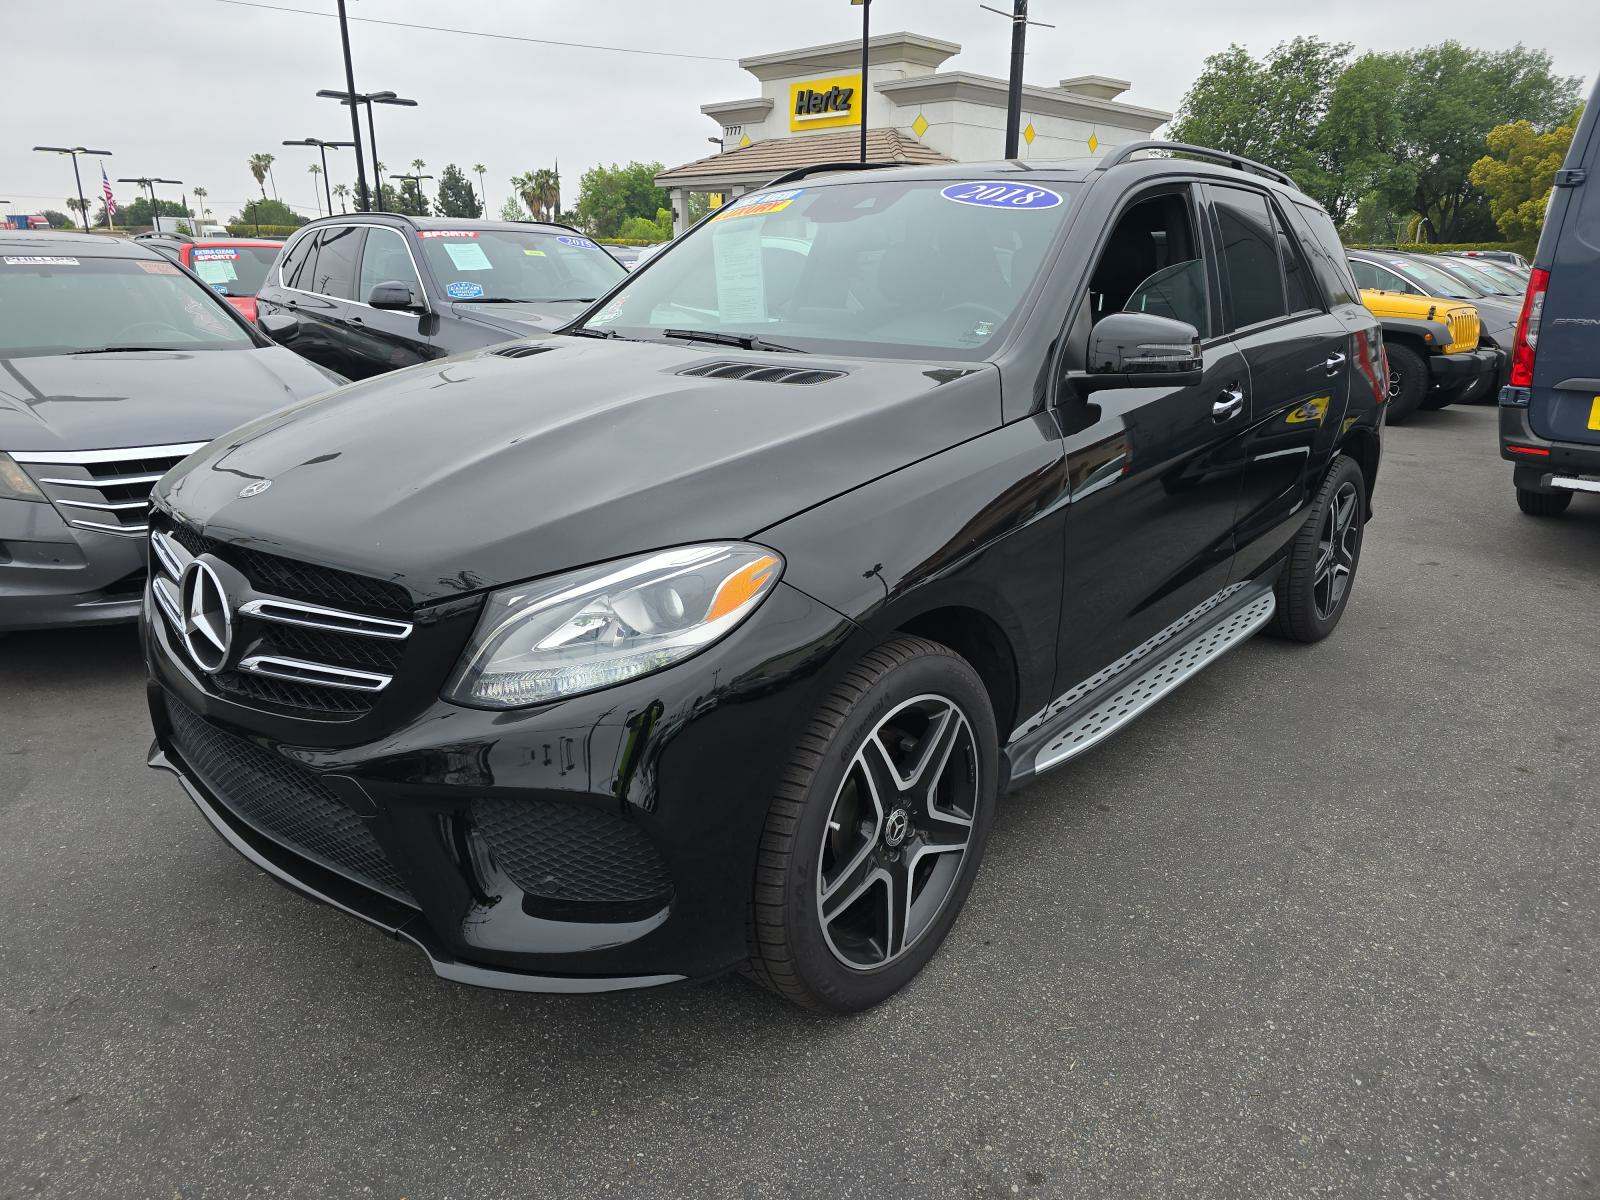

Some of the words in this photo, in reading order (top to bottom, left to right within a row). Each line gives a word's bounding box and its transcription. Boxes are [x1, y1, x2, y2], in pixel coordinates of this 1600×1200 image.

[794, 85, 854, 115] Hertz
[724, 125, 742, 137] 7777
[953, 185, 1046, 205] 2018
[422, 230, 475, 238] SPORTY
